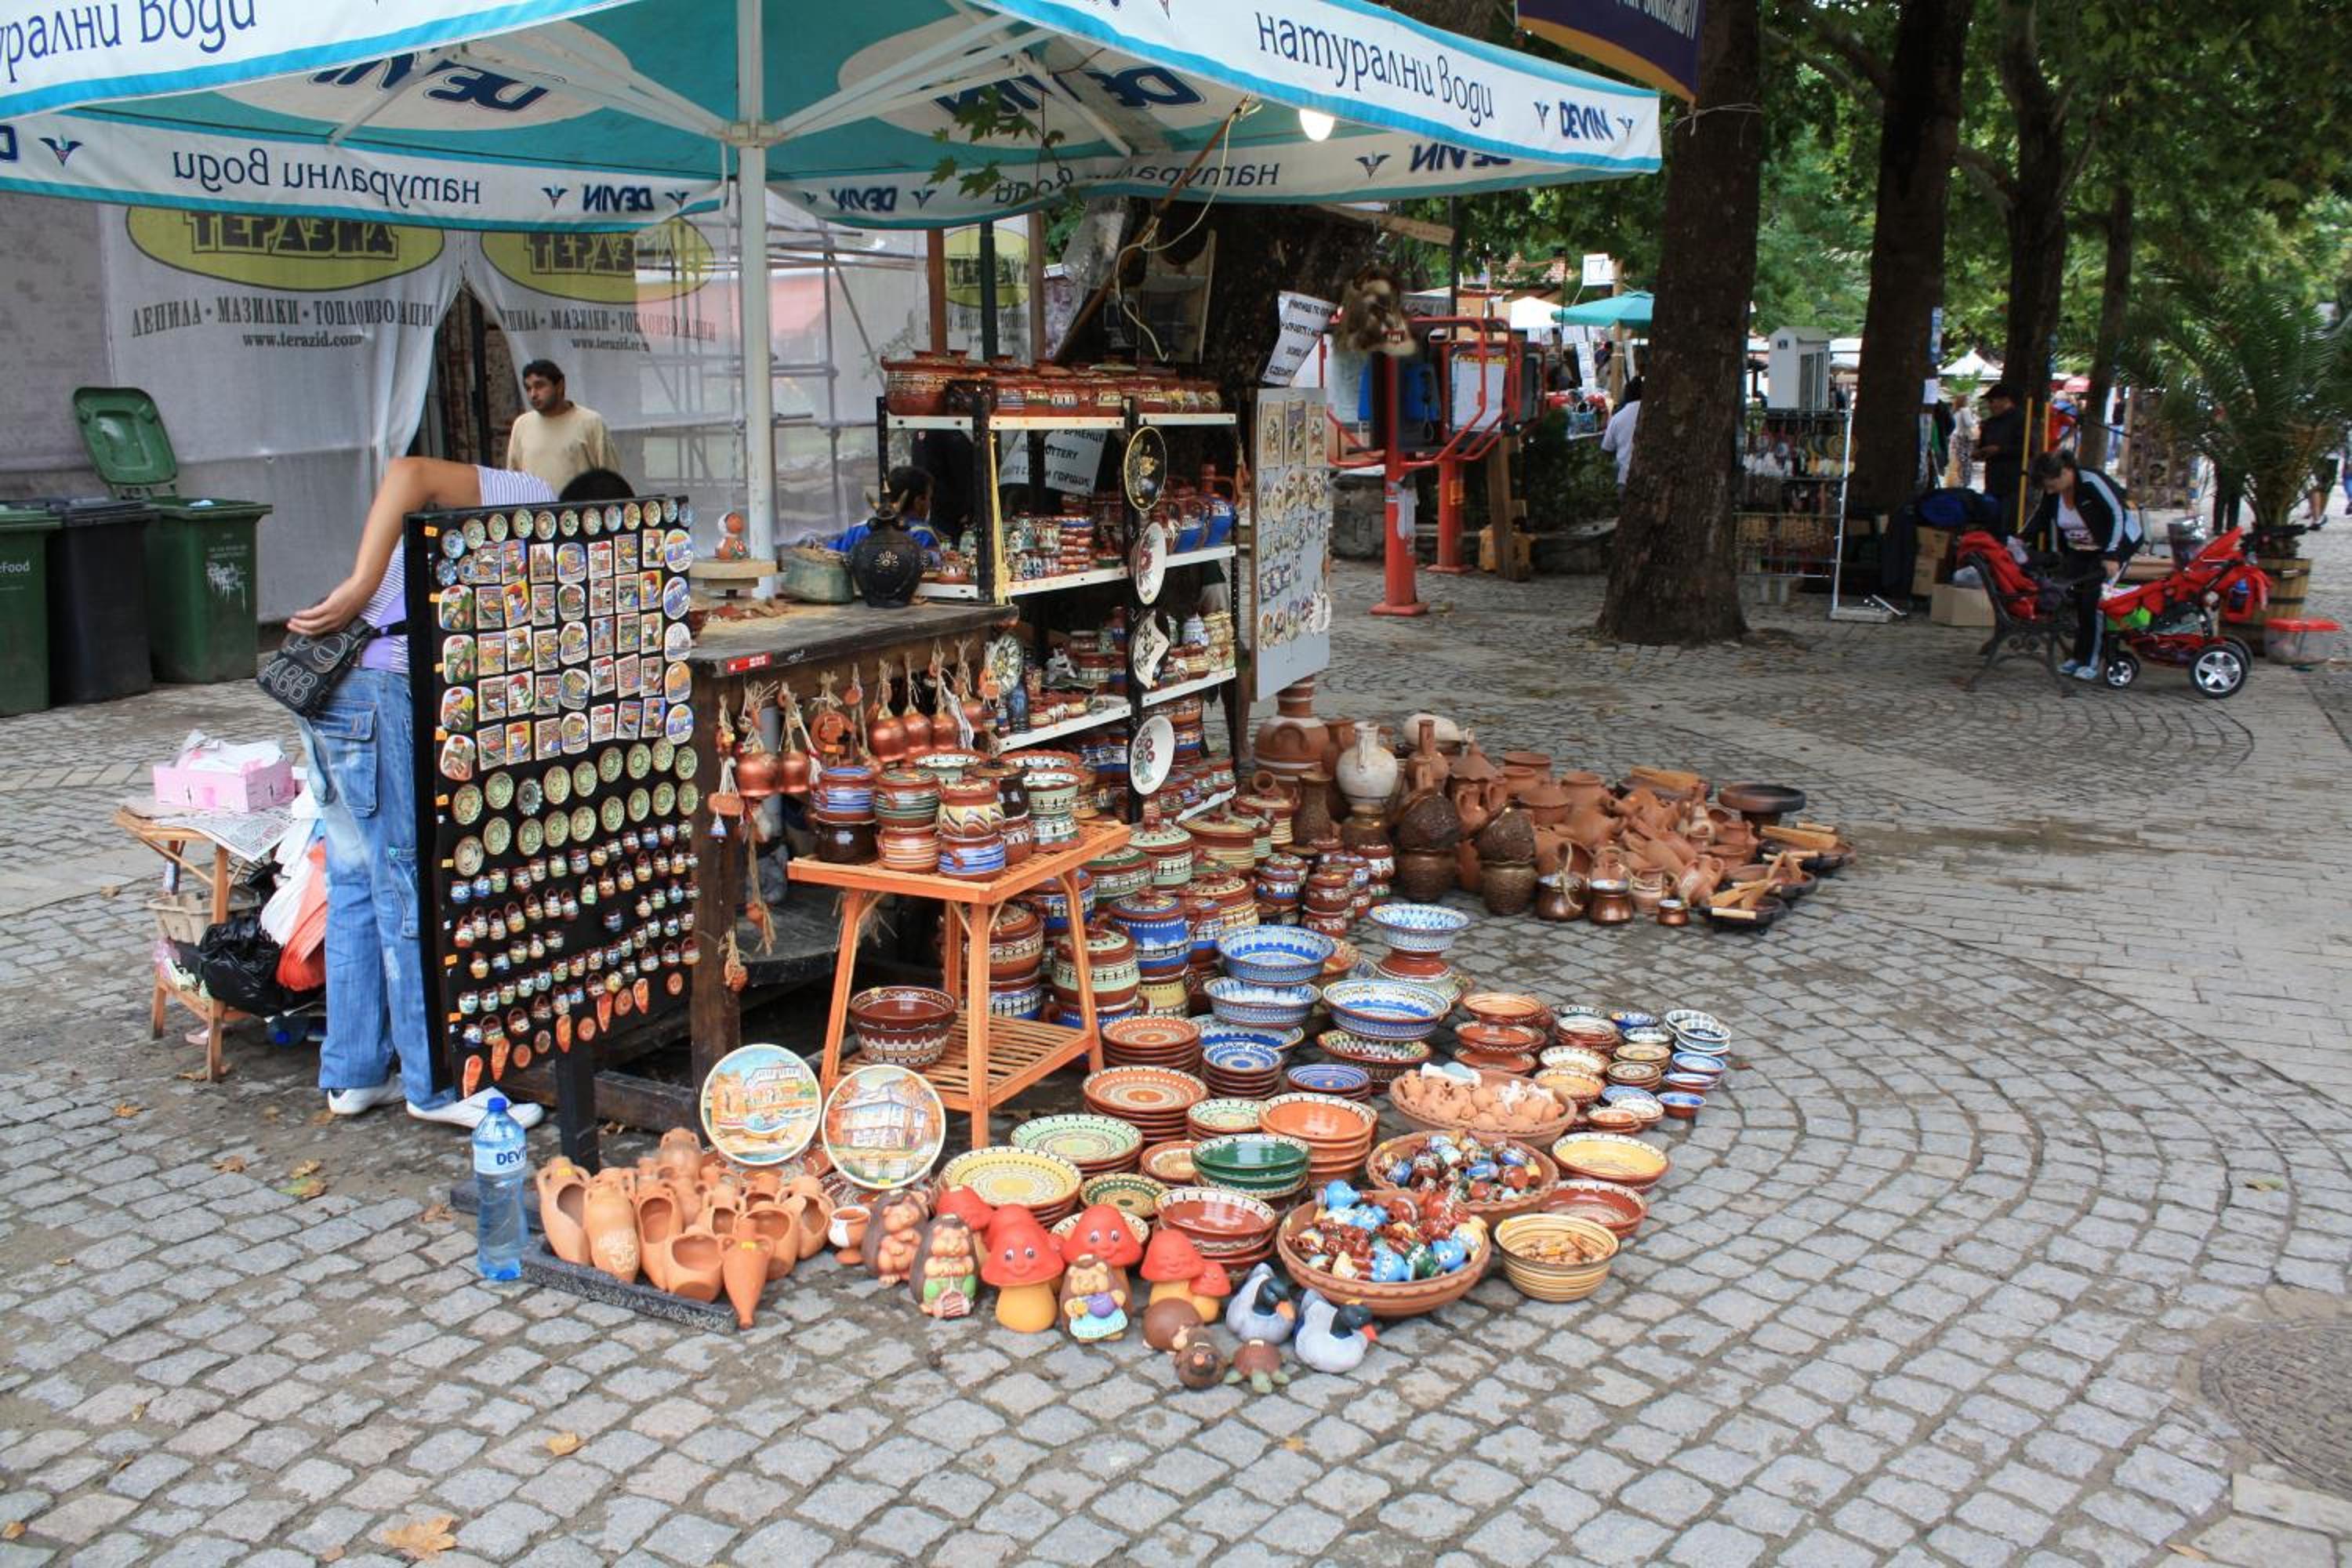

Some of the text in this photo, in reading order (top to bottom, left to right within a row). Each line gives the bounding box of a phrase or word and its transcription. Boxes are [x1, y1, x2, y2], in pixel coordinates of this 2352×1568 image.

[1255, 11, 1495, 129] натурални води
[1559, 101, 1615, 141] DEVIN
[216, 296, 299, 325] МАЗИЛКИ
[1045, 445, 1079, 460] OTTERY
